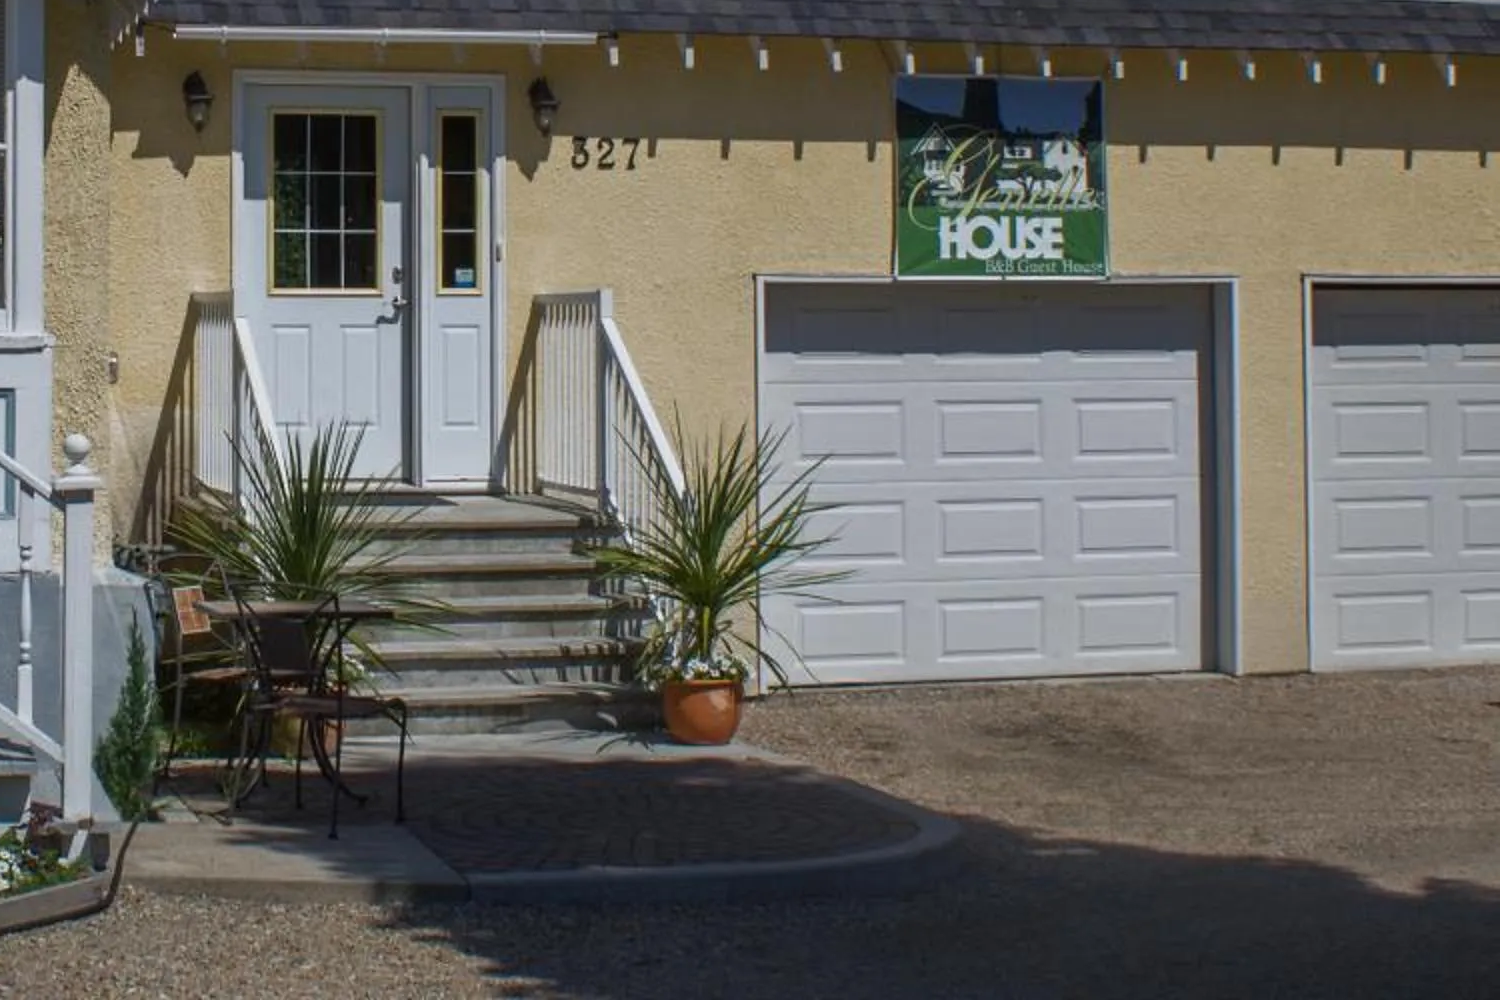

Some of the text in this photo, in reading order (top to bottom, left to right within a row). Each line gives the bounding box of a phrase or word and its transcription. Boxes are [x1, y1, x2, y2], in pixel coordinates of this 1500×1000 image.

[571, 135, 641, 170] 327
[939, 215, 1064, 260] HOUSE
[985, 258, 1104, 274] B&B Guest House
